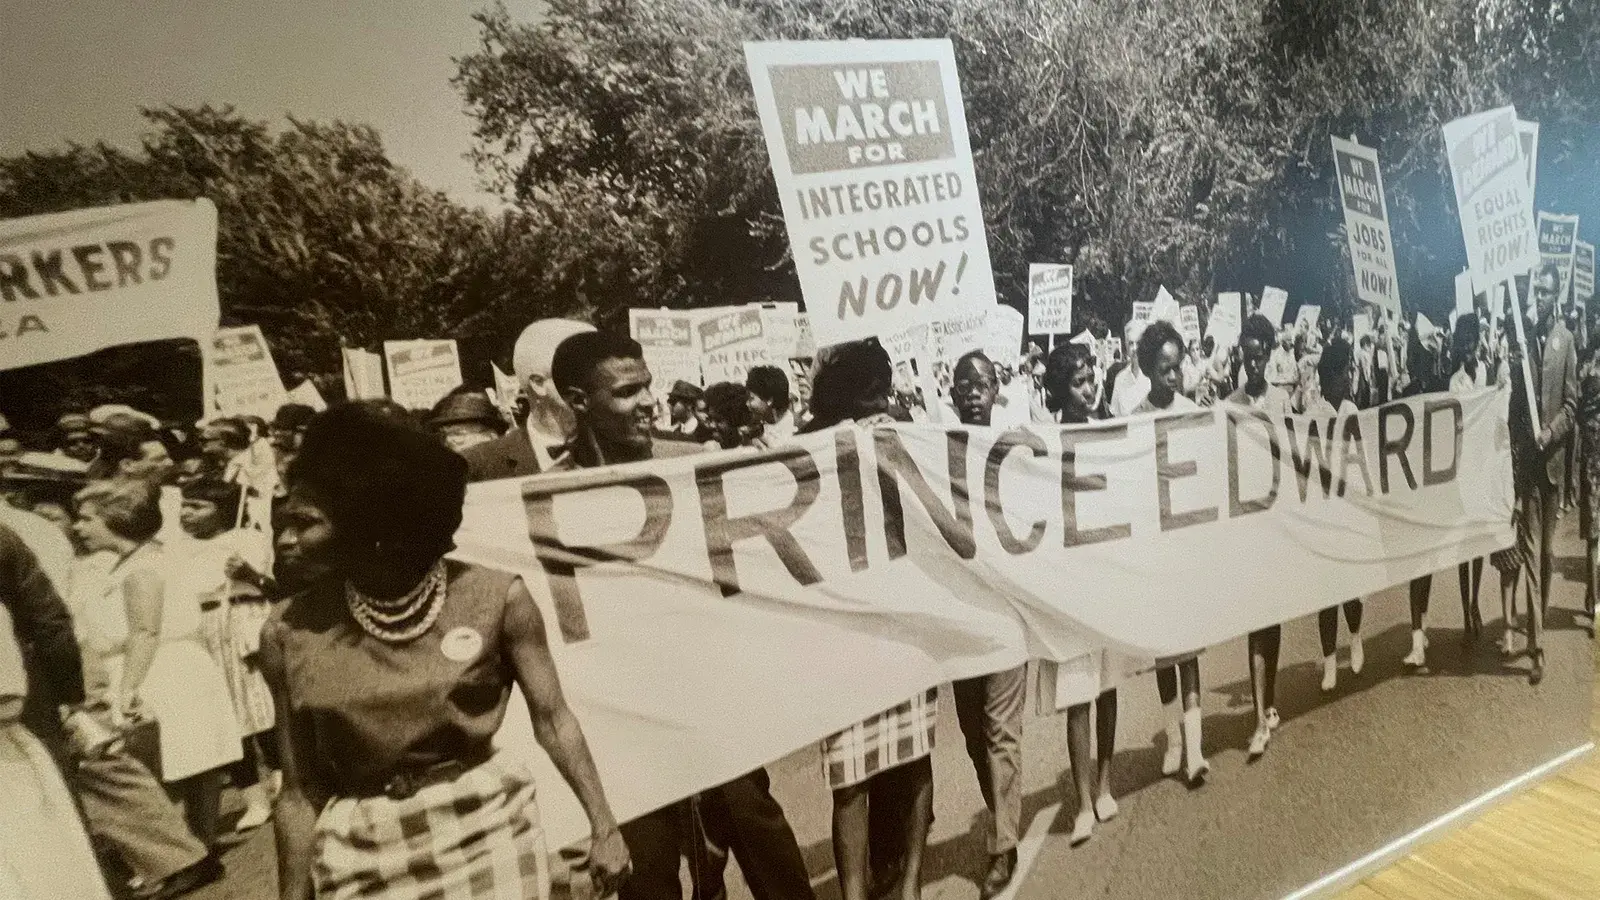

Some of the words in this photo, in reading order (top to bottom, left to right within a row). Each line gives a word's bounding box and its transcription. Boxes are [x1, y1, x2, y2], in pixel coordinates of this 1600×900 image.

[834, 69, 890, 99] WE
[795, 100, 940, 147] MARCH
[848, 142, 907, 164] FOR
[1350, 157, 1364, 178] WE
[797, 171, 962, 221] INTEGRATED
[1343, 174, 1380, 204] MARCH
[1474, 187, 1522, 222] EQUAL
[809, 215, 970, 266] SCHOOLS
[1353, 222, 1386, 253] JOBS
[1477, 209, 1528, 247] RIGHTS
[1541, 232, 1572, 246] MARCH
[1483, 229, 1530, 275] NOW!
[837, 251, 969, 321] NOW!
[1361, 269, 1393, 300] NOW!
[709, 352, 729, 366] AN
[735, 349, 768, 364] FEPC
[522, 423, 1132, 644] PRINCE
[1155, 398, 1463, 532] EDWARD
